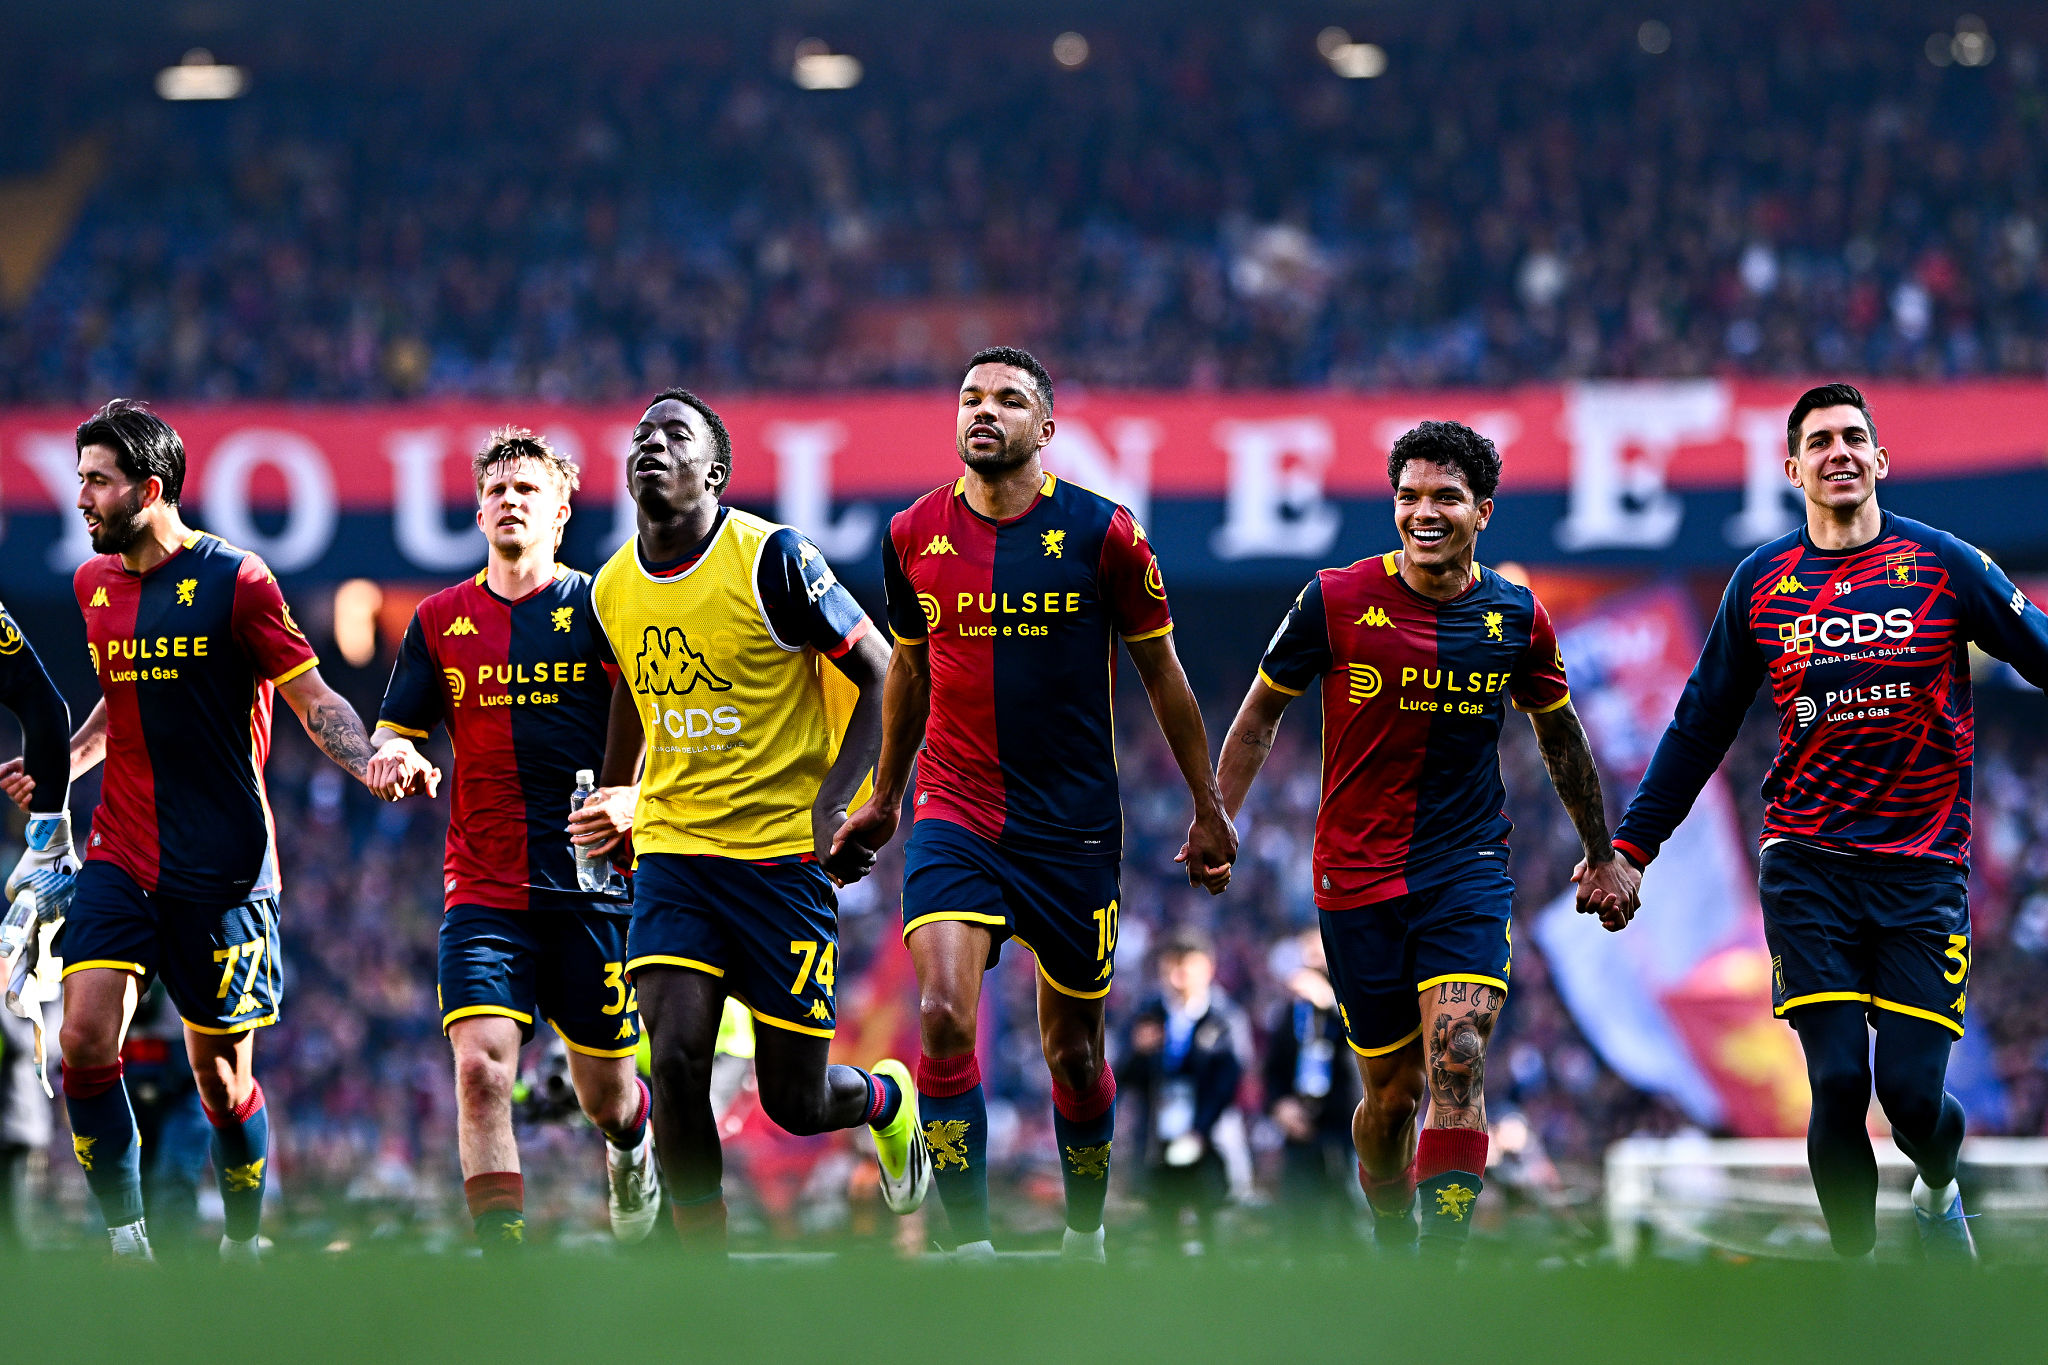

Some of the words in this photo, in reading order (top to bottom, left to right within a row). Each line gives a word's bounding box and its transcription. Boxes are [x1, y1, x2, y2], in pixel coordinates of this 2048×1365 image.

[1834, 581, 1852, 596] 39
[957, 592, 1081, 613] PULSEE
[959, 623, 998, 637] Luce
[1003, 624, 1012, 636] e
[1017, 623, 1049, 636] Gas
[1819, 608, 1914, 647] CDS
[107, 636, 208, 661] PULSEE
[1781, 664, 1792, 673] LA
[1793, 658, 1812, 670] TUA
[1814, 655, 1841, 666] CASA
[1843, 650, 1876, 662] DELLA
[1878, 646, 1917, 657] SALUTE
[110, 669, 138, 683] Luce
[141, 669, 149, 680] e
[151, 666, 179, 680] Gas
[478, 662, 587, 685] PULSEE
[480, 693, 513, 707] Luce
[517, 694, 526, 705] e
[530, 691, 559, 704] Gas
[1400, 697, 1438, 712] Luce
[1443, 702, 1453, 713] e
[1458, 701, 1484, 714] Gas
[1825, 682, 1912, 707] PULSEE
[663, 705, 742, 739] CDS
[1827, 710, 1855, 722] Luce
[1857, 710, 1865, 719] e
[1868, 707, 1890, 718] Gas
[682, 745, 709, 754] DELLA
[1093, 899, 1118, 961] 10
[213, 936, 265, 998] 77
[790, 940, 835, 997] 74
[1943, 934, 1971, 985] 3
